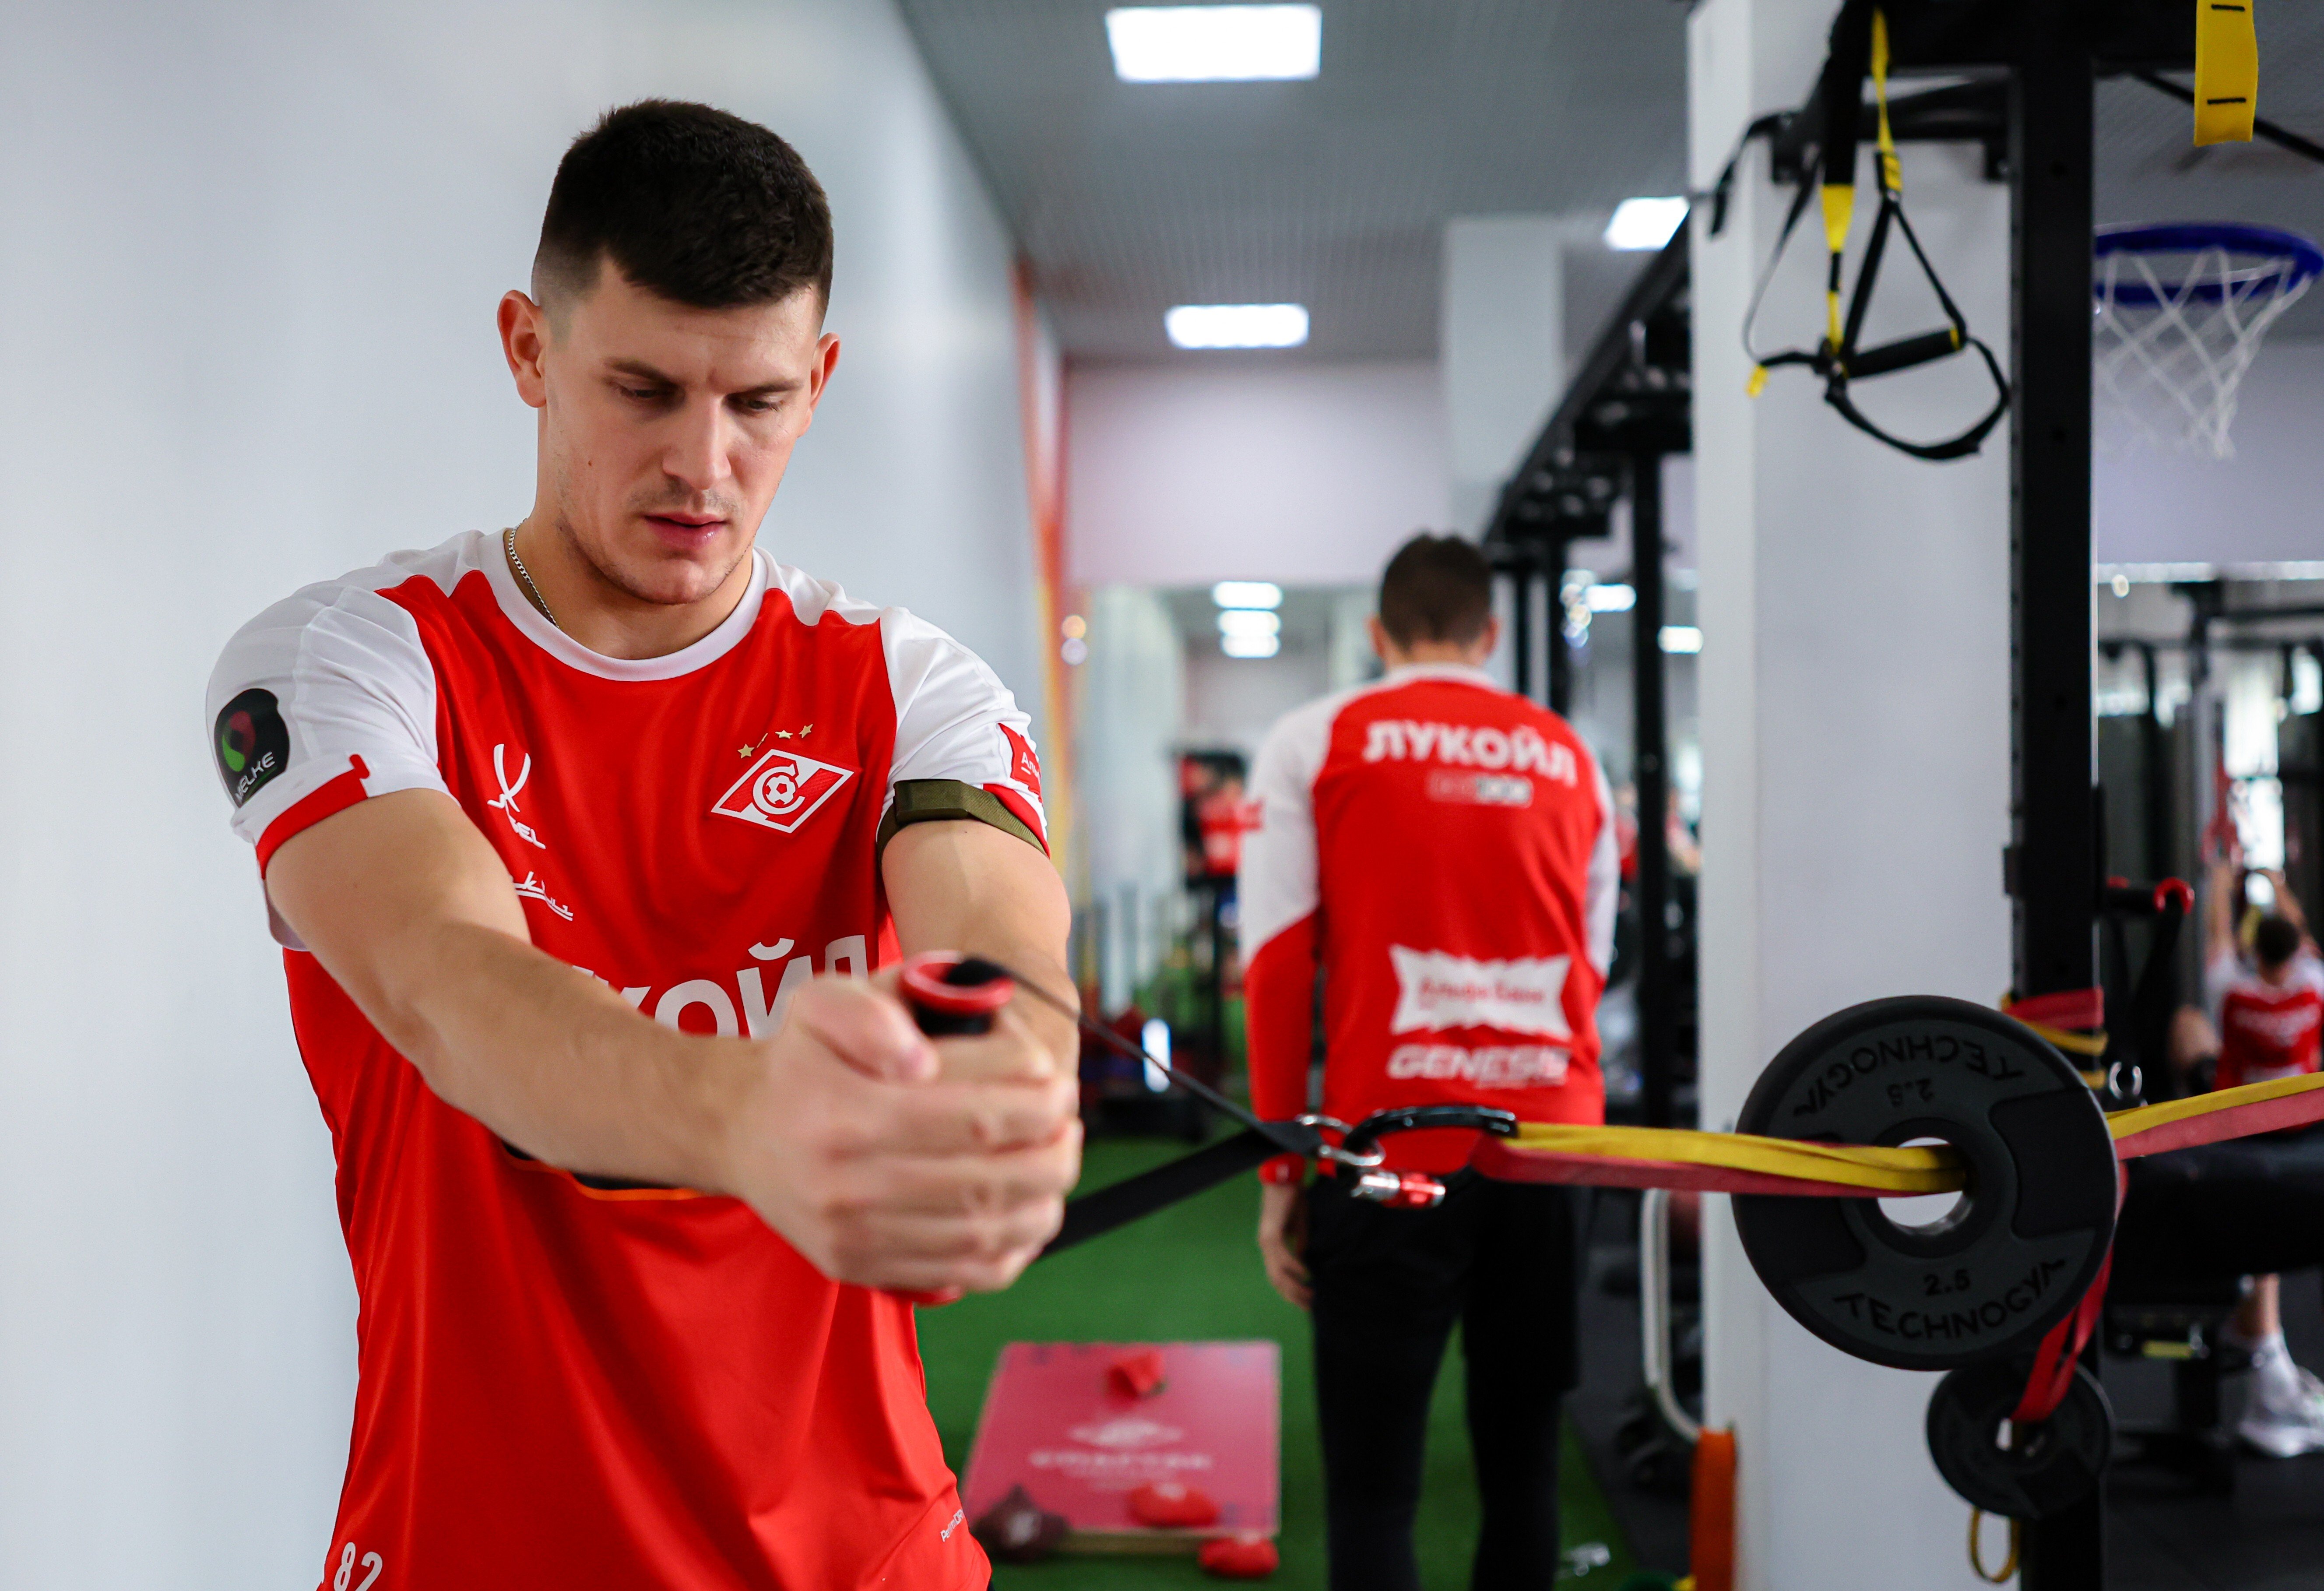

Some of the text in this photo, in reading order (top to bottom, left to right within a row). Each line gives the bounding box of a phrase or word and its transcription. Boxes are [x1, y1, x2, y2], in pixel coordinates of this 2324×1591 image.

[1363, 720, 1577, 786] ЛУКОЙЛ
[1793, 1035, 2025, 1117] TECHNOGYM
[1887, 1077, 1934, 1108] 2.5
[1833, 1257, 2066, 1340] TECHNOGYM
[1923, 1268, 1972, 1297] 2.5
[334, 1542, 383, 1591] 82
